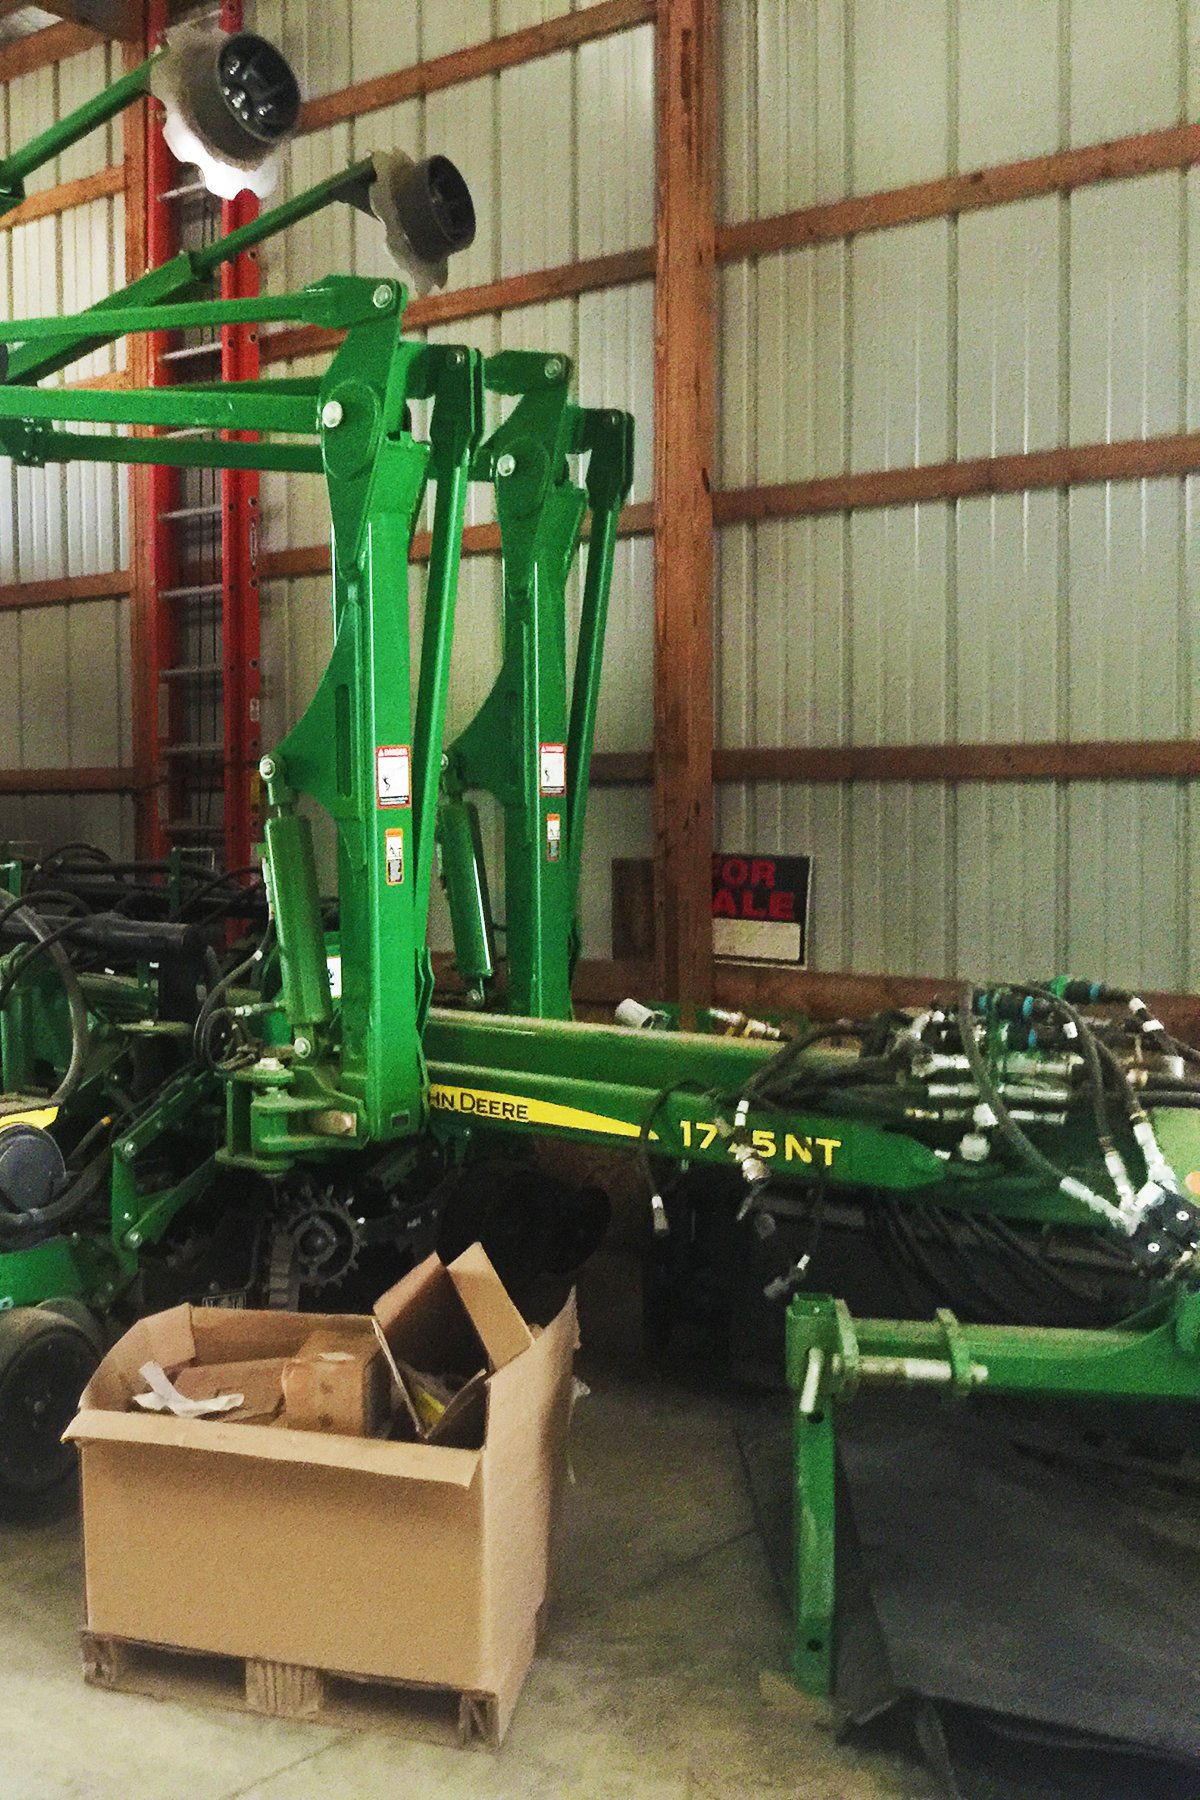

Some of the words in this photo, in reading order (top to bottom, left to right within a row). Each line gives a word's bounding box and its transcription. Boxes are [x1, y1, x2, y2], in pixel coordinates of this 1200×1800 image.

[716, 857, 776, 888] OR
[711, 888, 795, 919] ALE
[429, 1091, 454, 1108] HN
[460, 1092, 529, 1120] DEERE
